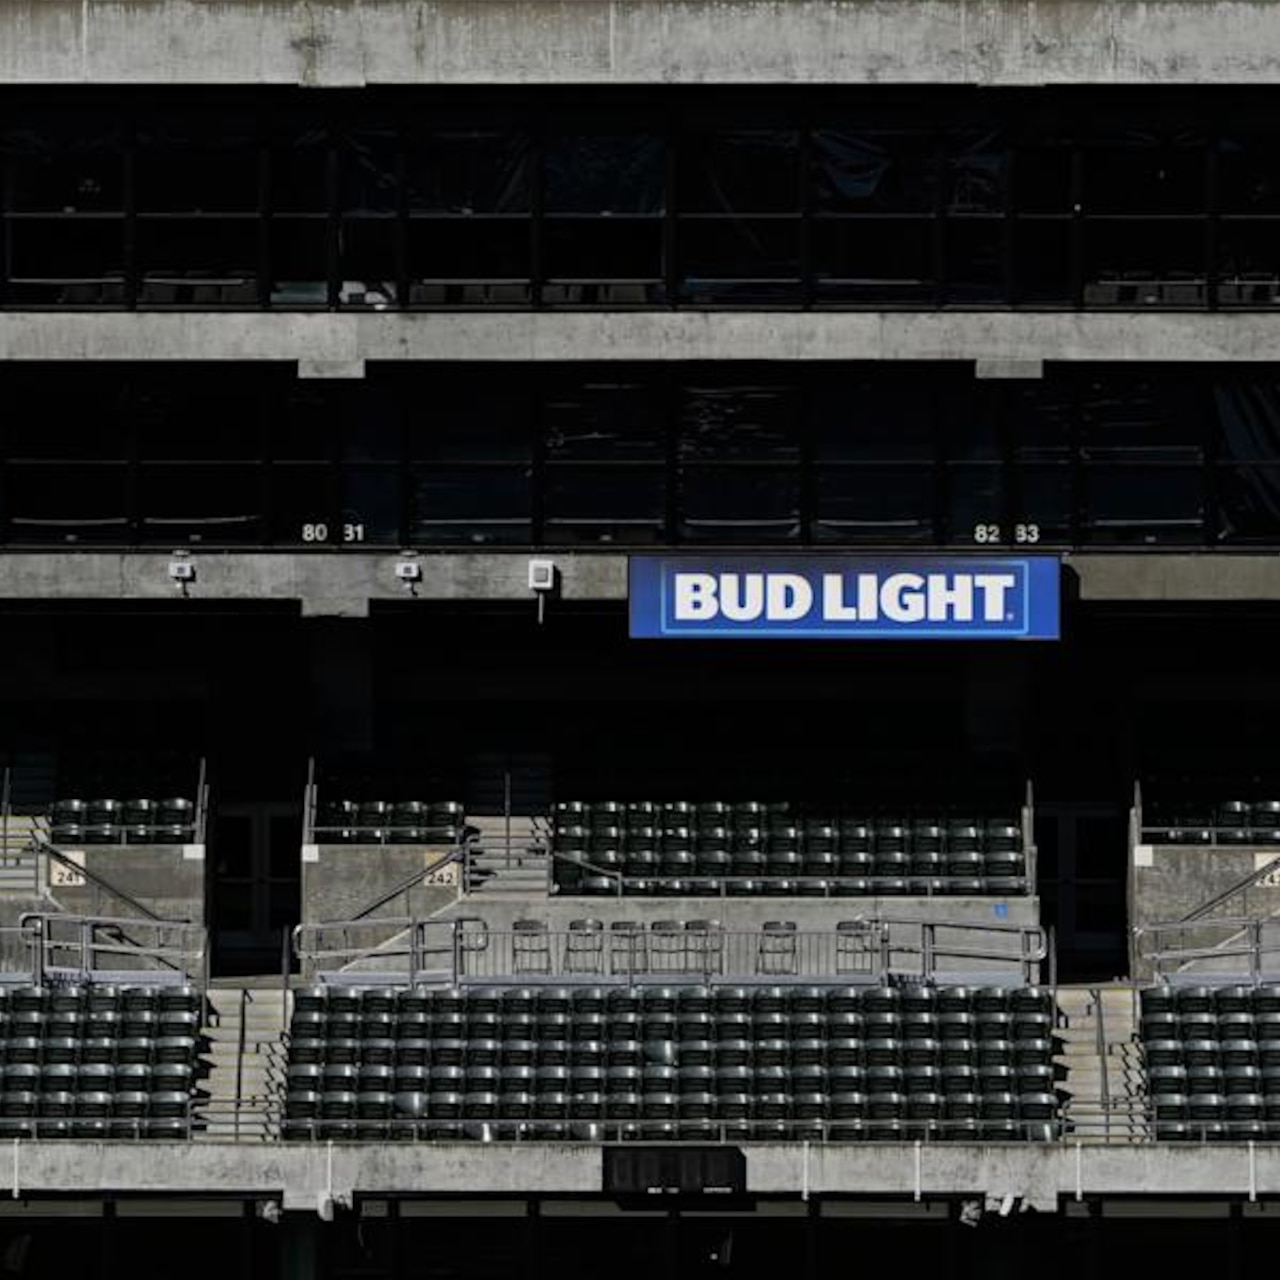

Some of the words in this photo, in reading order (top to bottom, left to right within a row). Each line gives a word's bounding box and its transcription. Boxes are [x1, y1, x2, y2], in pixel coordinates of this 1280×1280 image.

[302, 523, 328, 541] 80
[974, 523, 1000, 543] 82
[674, 572, 813, 621] BUD
[823, 572, 1015, 622] LIGHT
